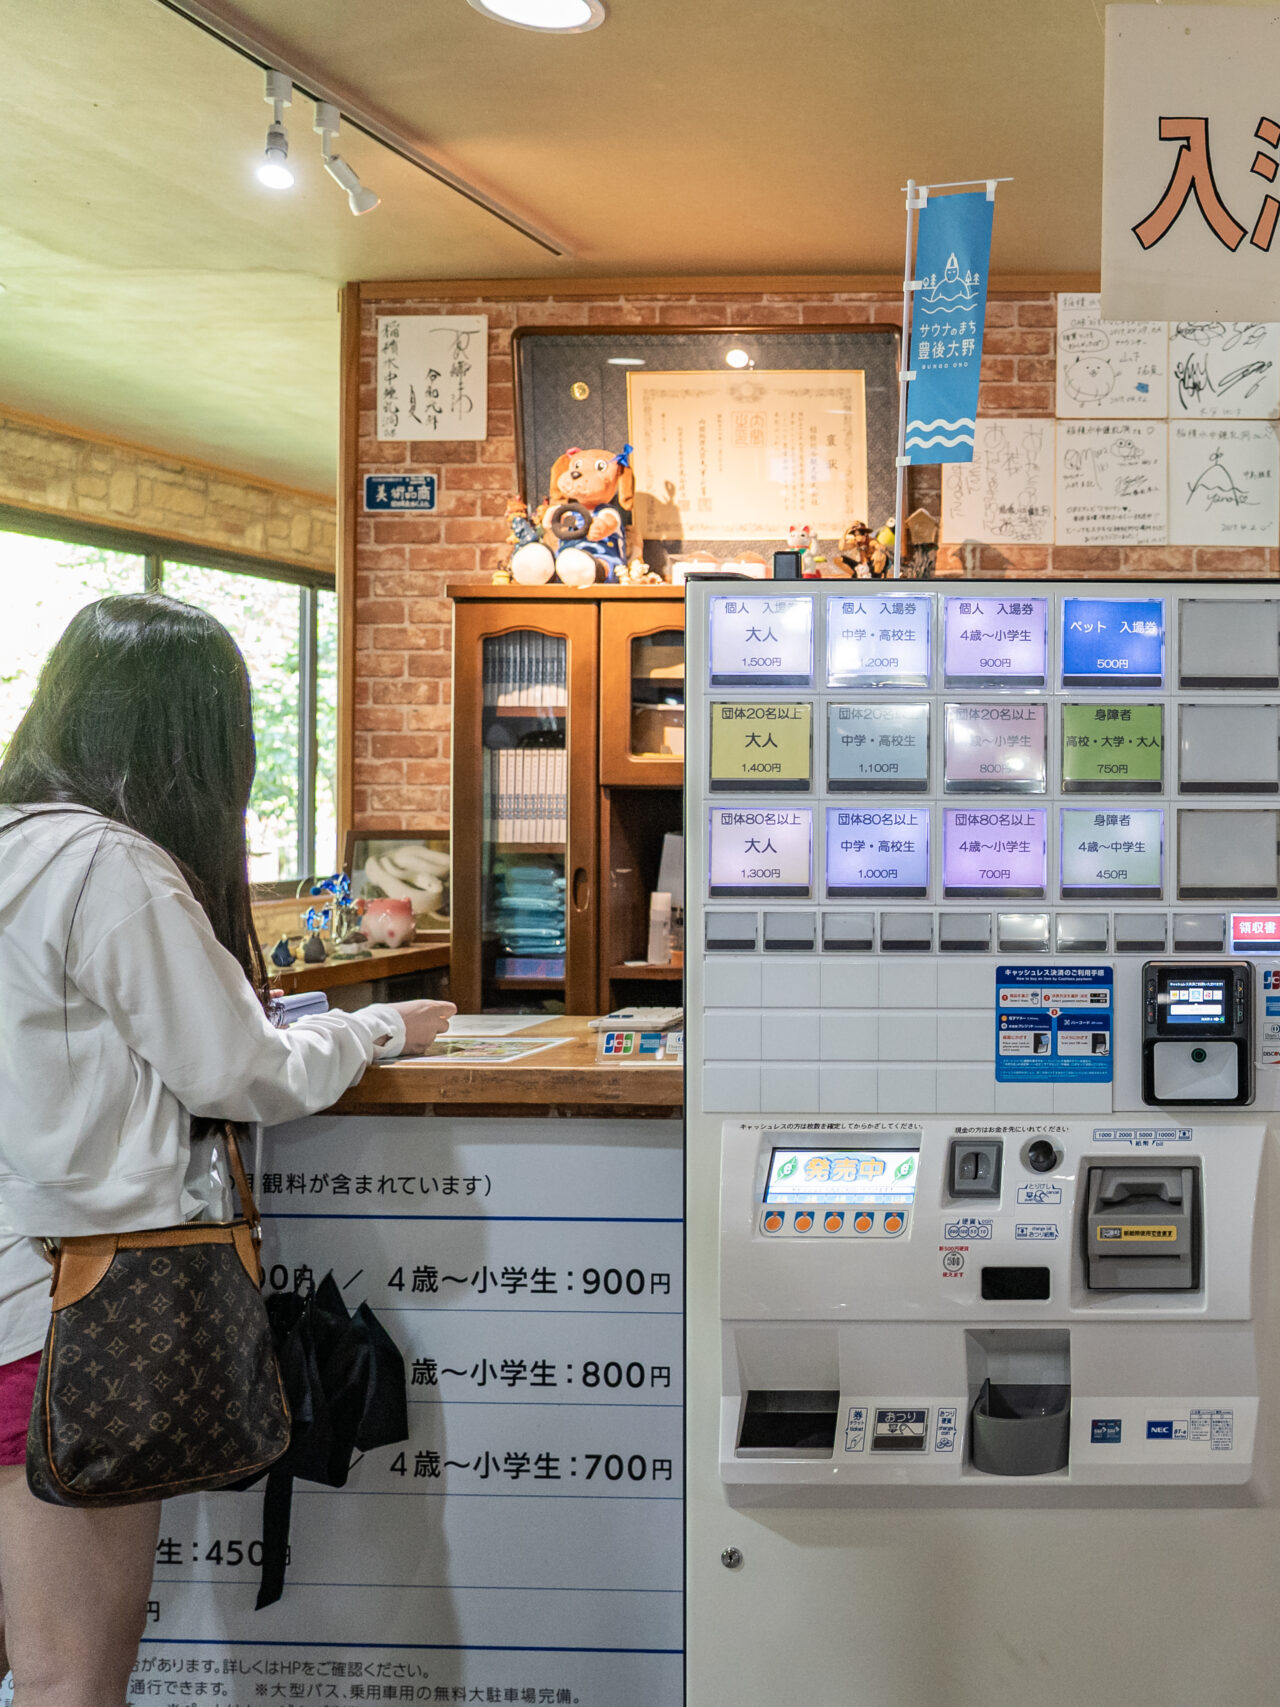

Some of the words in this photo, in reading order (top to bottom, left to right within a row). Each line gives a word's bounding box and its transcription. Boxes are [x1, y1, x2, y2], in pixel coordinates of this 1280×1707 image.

[919, 321, 977, 338] サウナのまち
[918, 339, 976, 360] 豊後大野
[724, 602, 749, 615] 個人
[842, 602, 867, 615] 個人
[880, 602, 917, 615] 入場券
[959, 602, 984, 616] 個人
[997, 602, 1034, 616] 入場券
[1070, 620, 1106, 633] ペット
[1120, 620, 1158, 634] 入場券
[745, 627, 778, 643] 大人
[841, 629, 916, 642] 中学・高校生
[979, 657, 1011, 668] 900円
[1097, 658, 1129, 669] 500円
[721, 708, 802, 721] 団体20名以上
[1094, 708, 1132, 721] 身障者
[745, 733, 778, 748] 大人
[841, 735, 916, 748] 中学・高校生
[1066, 735, 1160, 748] 高校・大学・大人
[1097, 763, 1129, 774] 750円
[721, 813, 802, 826] 団体80名以上
[838, 813, 919, 826] 団体80名以上
[955, 813, 1036, 826] 団体80名以上
[1093, 814, 1131, 827] 身障者
[744, 838, 778, 854] 大人
[840, 840, 915, 854] 中学・高校生
[979, 868, 1011, 879] 700円
[1096, 869, 1128, 880] 450円
[1239, 921, 1276, 934] 領収書
[804, 1156, 886, 1181] 発売中
[885, 1411, 916, 1423] おつり
